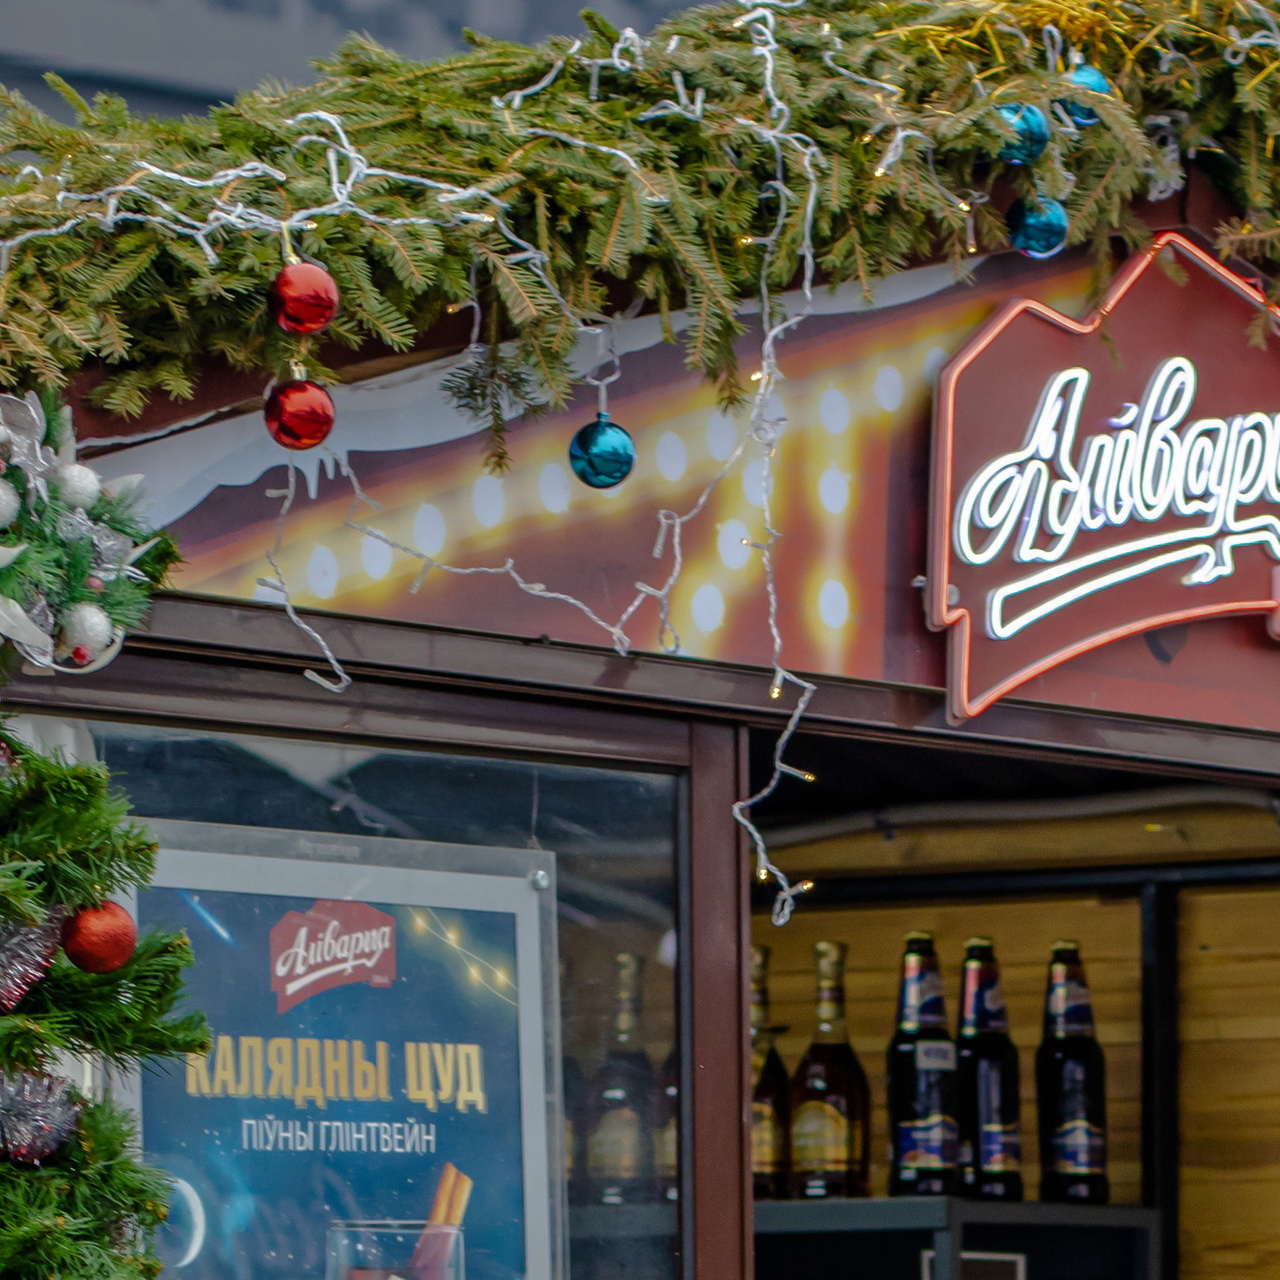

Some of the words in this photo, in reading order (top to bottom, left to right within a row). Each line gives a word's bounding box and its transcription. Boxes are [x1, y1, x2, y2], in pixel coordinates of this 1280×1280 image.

[185, 1035, 391, 1110] КАЛЯДНЫ
[404, 1042, 486, 1114] ЦУД
[241, 1112, 314, 1151] ПІЎНЫ
[318, 1116, 437, 1153] ГЛІНТВЕЙН
